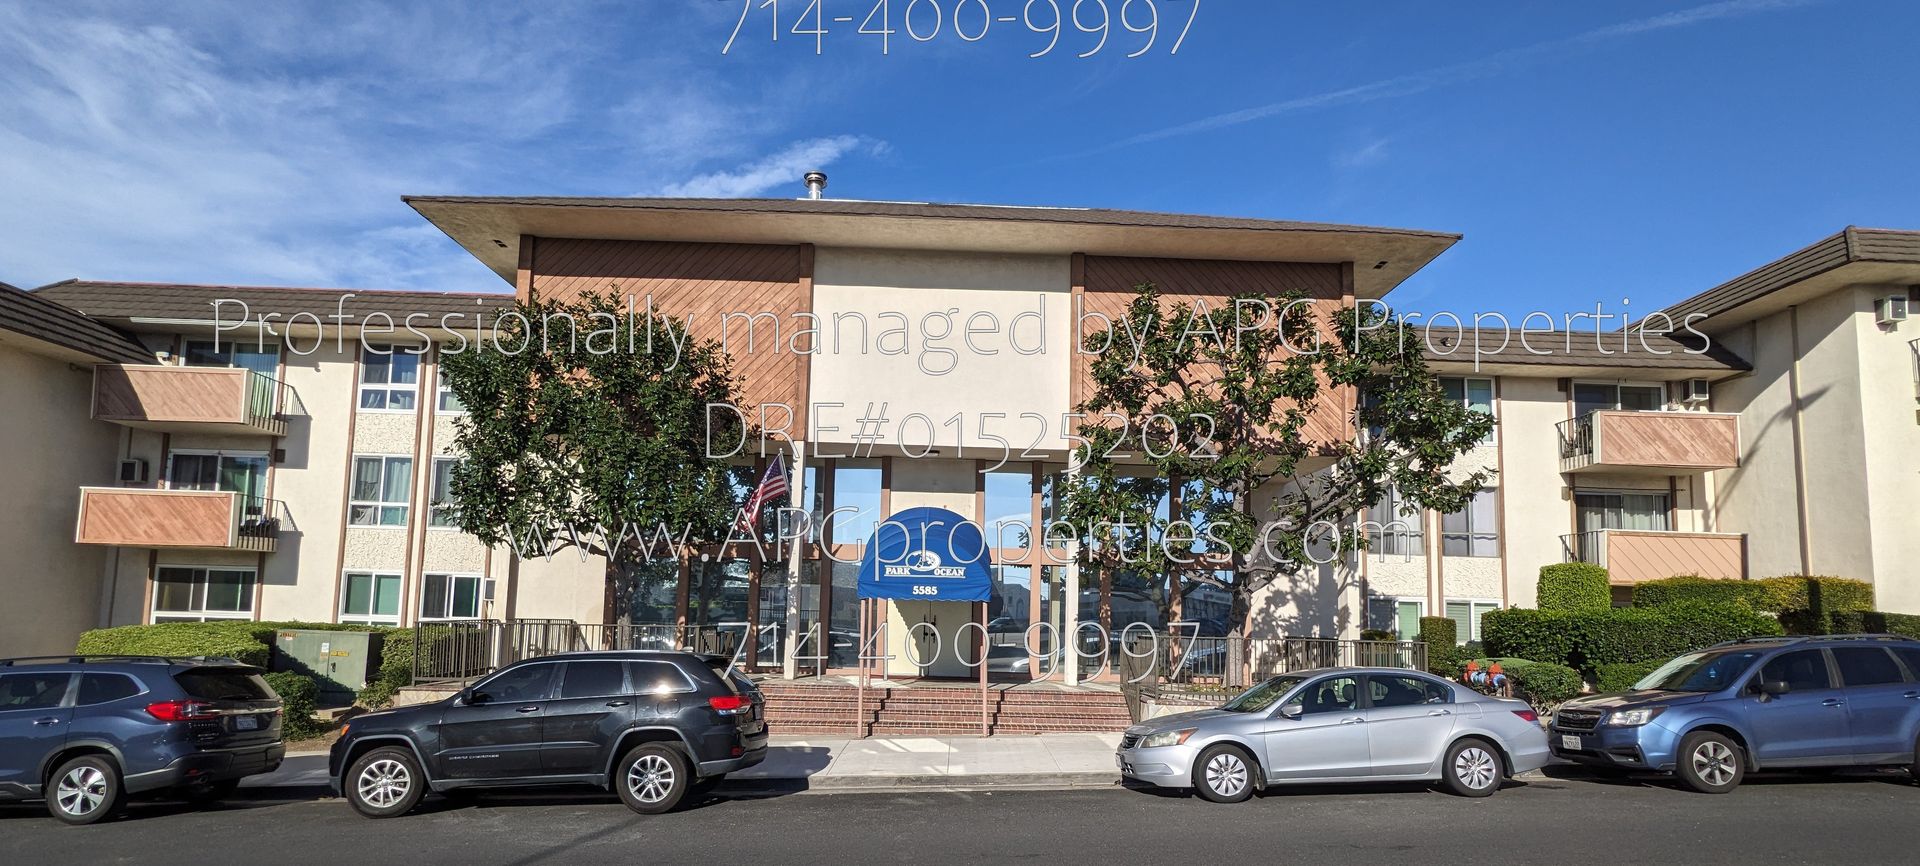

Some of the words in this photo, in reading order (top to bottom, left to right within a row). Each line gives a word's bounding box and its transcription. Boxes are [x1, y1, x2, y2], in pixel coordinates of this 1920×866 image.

[885, 567, 911, 575] PARK
[934, 568, 965, 576] OCEAN
[912, 586, 938, 595] 5585
